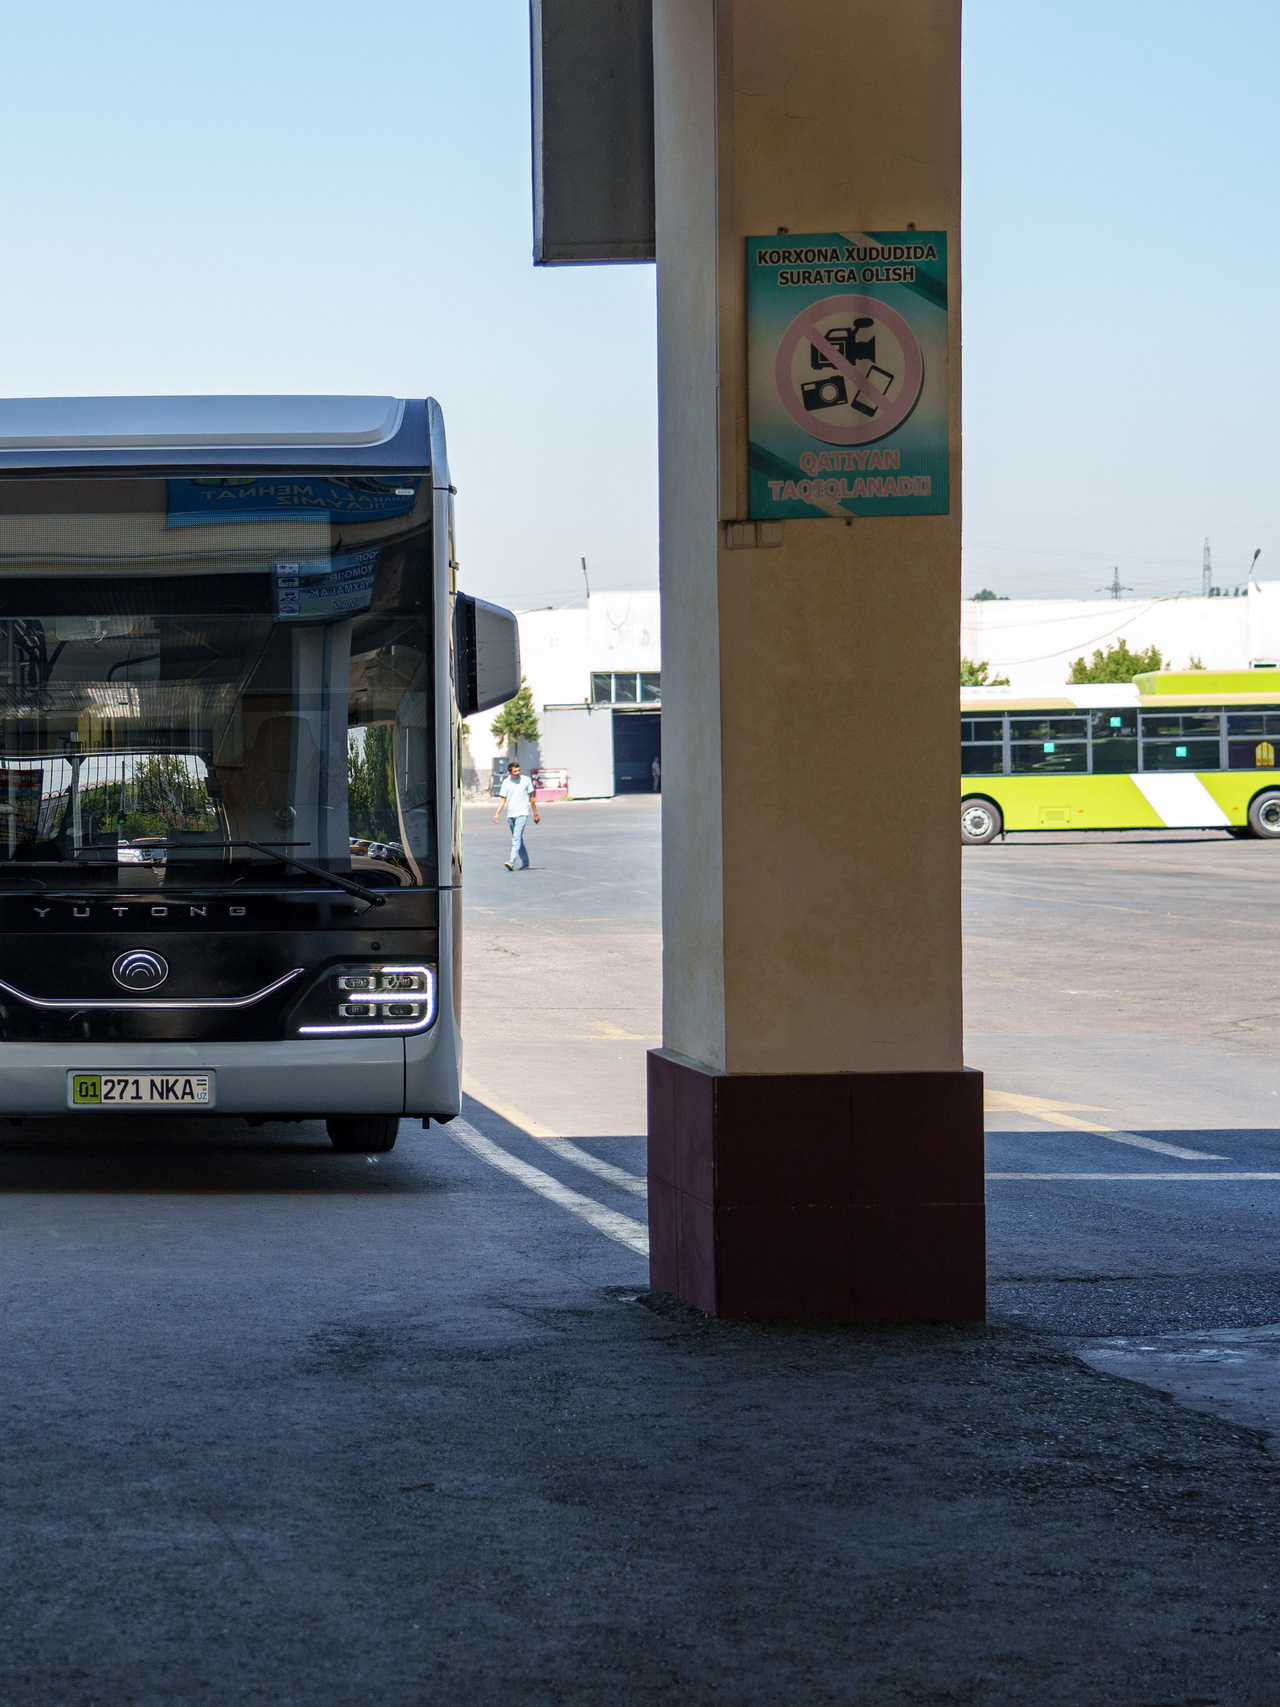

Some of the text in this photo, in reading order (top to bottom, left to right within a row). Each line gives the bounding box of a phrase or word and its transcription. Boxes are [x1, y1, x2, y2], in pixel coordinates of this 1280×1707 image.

[757, 244, 937, 264] KORXONA XUDUDIDA
[778, 266, 915, 285] SURATGA OLISH
[799, 450, 900, 475] QATIYAN
[767, 476, 931, 503] TAQIQLANADI!
[34, 906, 247, 918] YUTONG
[78, 1078, 208, 1101] 01 271 NKA UZ
